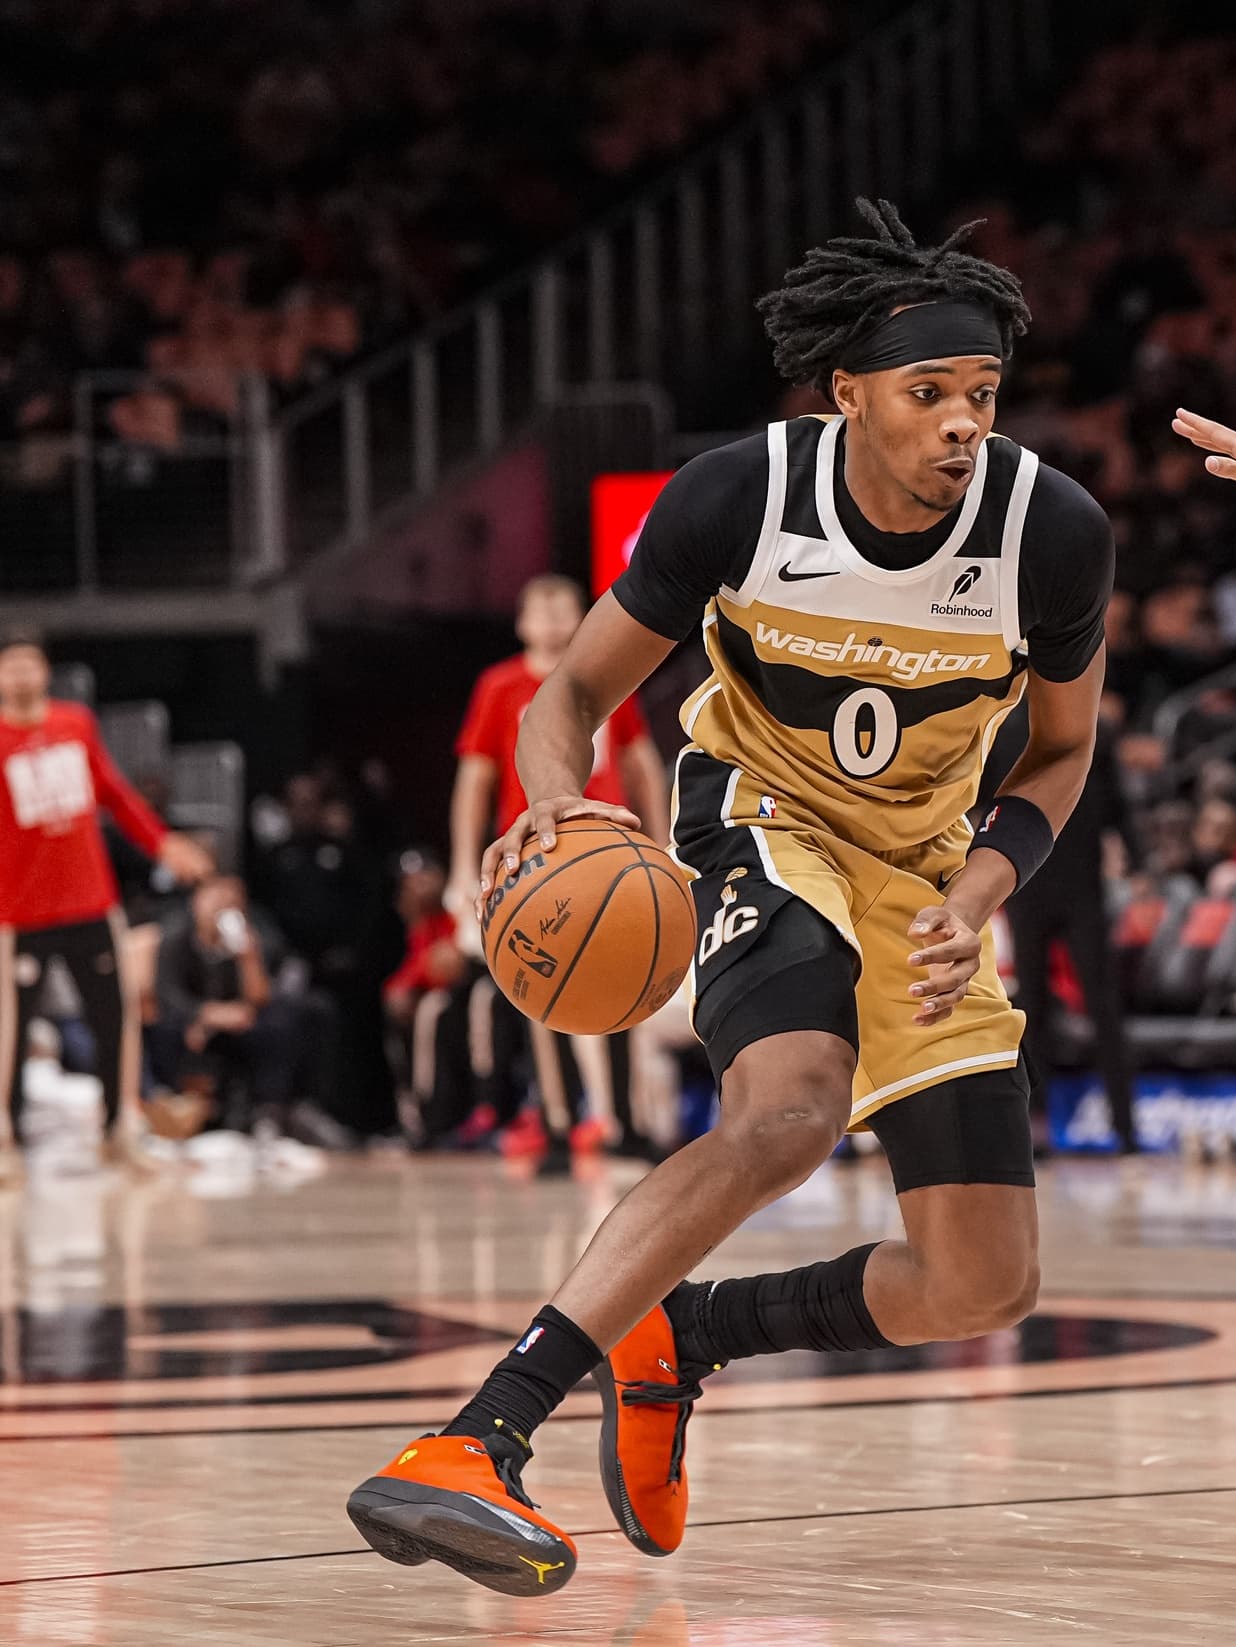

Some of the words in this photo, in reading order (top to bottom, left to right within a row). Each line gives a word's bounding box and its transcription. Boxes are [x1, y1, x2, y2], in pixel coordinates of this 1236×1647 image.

[930, 603, 993, 618] Robinhood
[756, 621, 991, 681] washington
[829, 685, 902, 780] 0
[698, 886, 760, 967] dc
